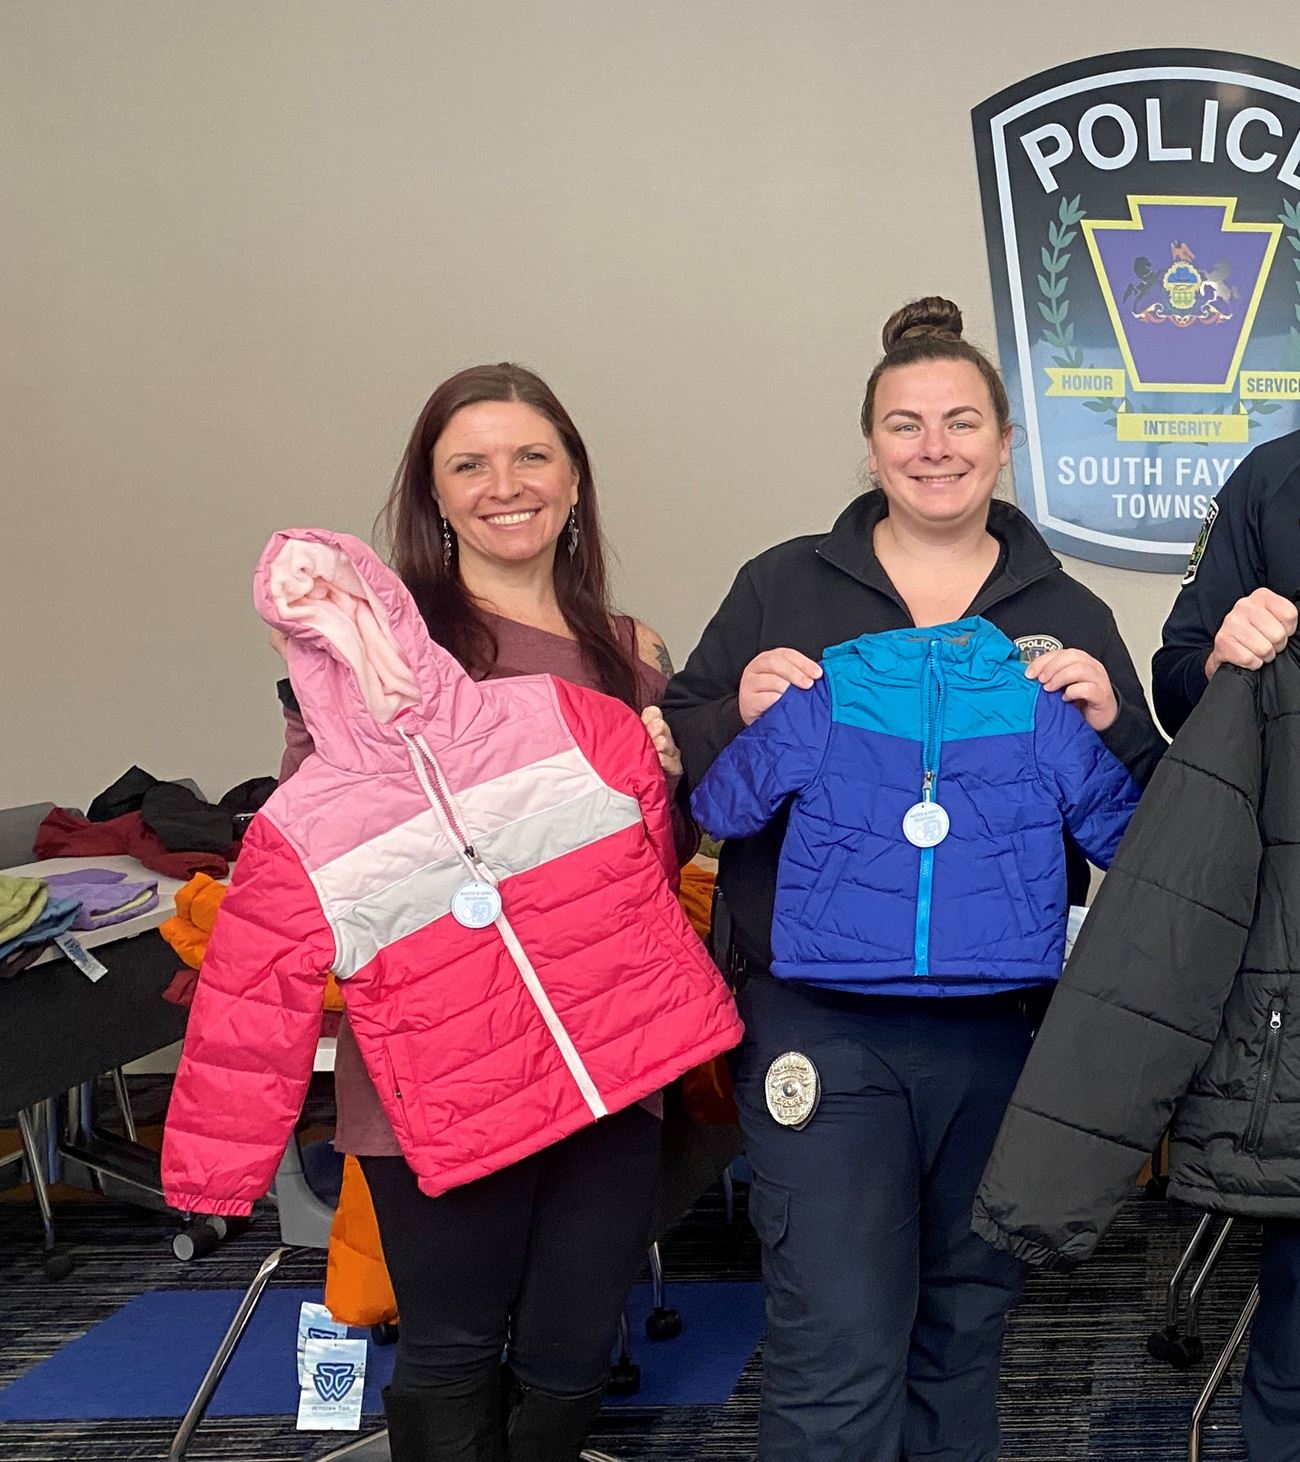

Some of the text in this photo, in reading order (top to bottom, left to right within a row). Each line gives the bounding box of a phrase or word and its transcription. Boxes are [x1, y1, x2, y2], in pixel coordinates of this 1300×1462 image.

[1061, 374, 1114, 392] HONOR
[1143, 420, 1223, 437] INTEGRITY
[1058, 456, 1162, 486] SOUTH
[1112, 494, 1214, 519] TOWNS
[1020, 640, 1058, 652] POLICE
[776, 1096, 804, 1105] POLICE
